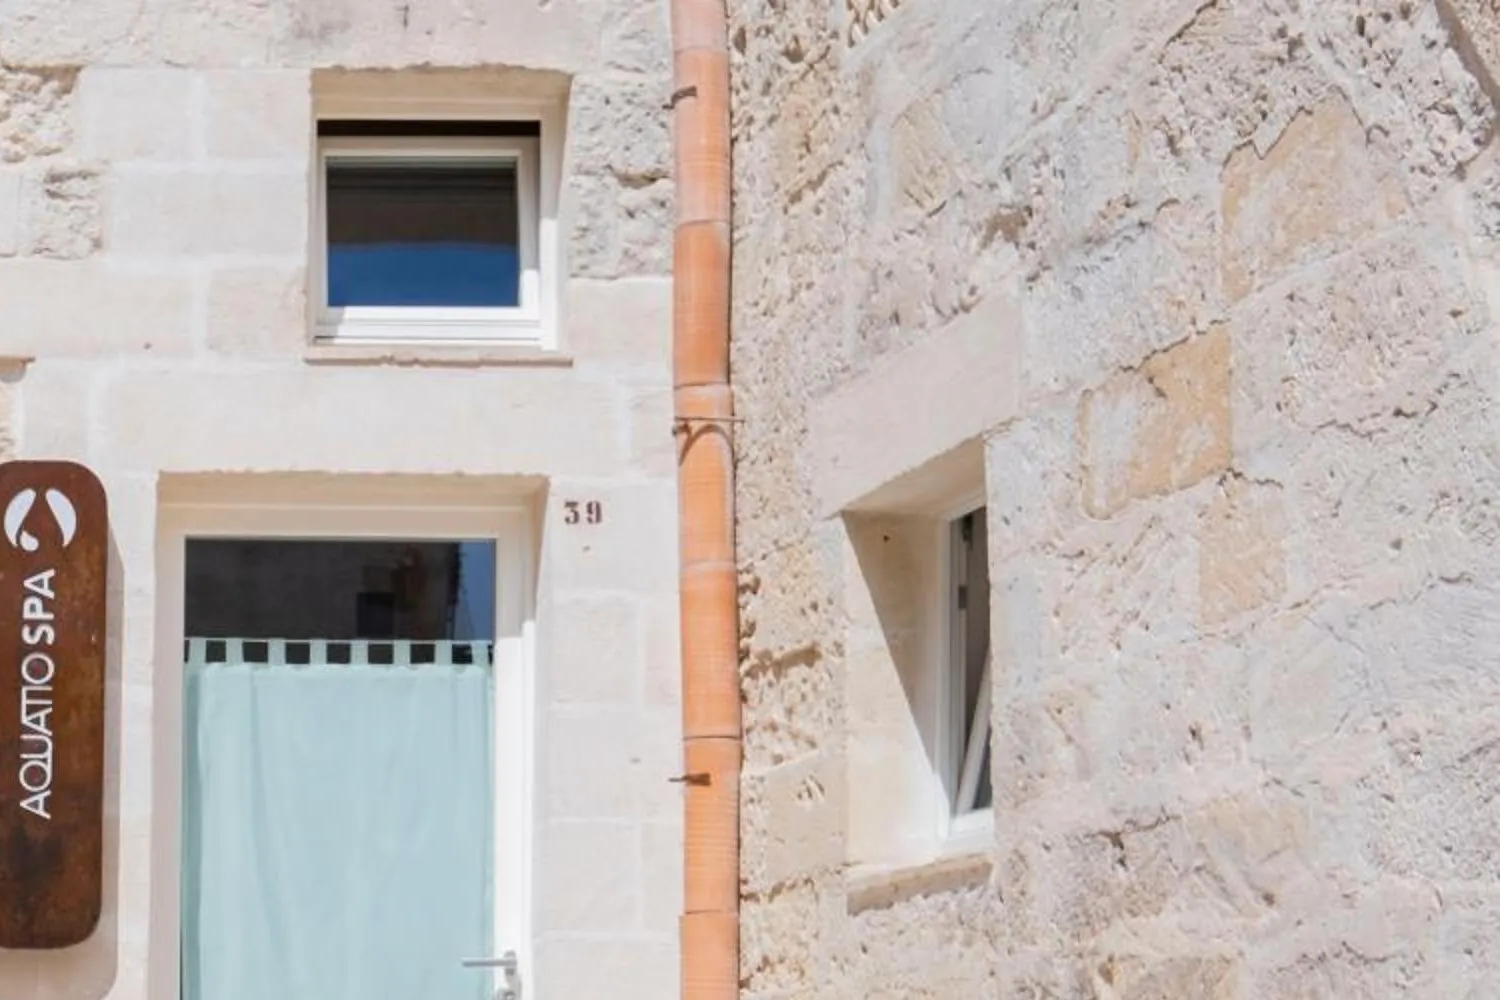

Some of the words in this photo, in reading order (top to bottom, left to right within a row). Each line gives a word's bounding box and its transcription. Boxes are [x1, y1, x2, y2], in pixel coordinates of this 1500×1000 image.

[564, 501, 602, 524] 39
[22, 568, 56, 646] SPA
[19, 652, 55, 819] AQUATIO
